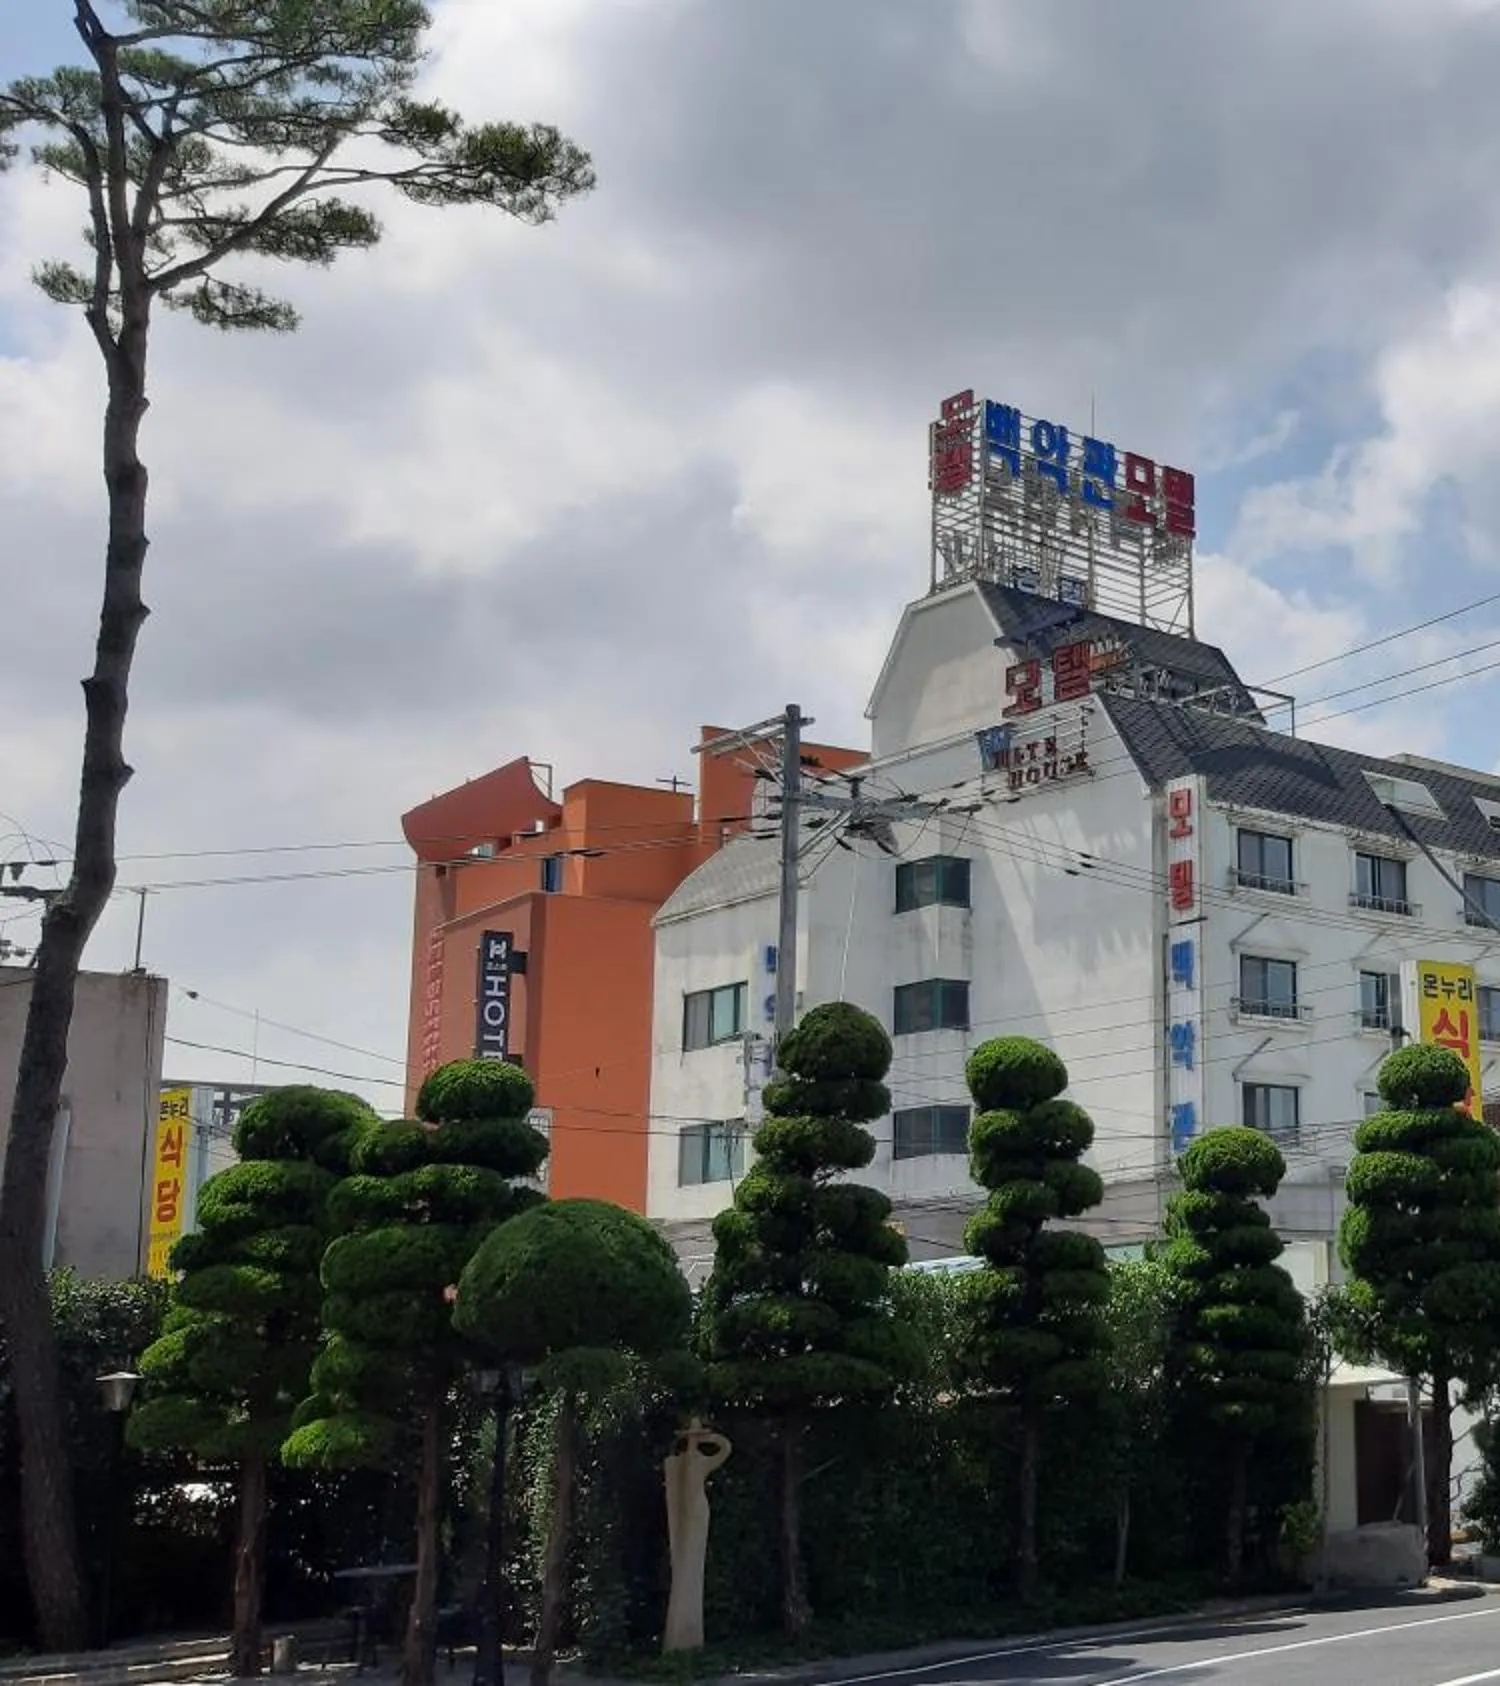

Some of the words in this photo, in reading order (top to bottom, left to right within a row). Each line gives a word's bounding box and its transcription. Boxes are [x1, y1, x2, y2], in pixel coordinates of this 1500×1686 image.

[1002, 640, 1091, 717] 모텔
[482, 976, 507, 1061] HOT
[1423, 973, 1473, 1002] 온누리
[157, 1125, 183, 1223] 식당
